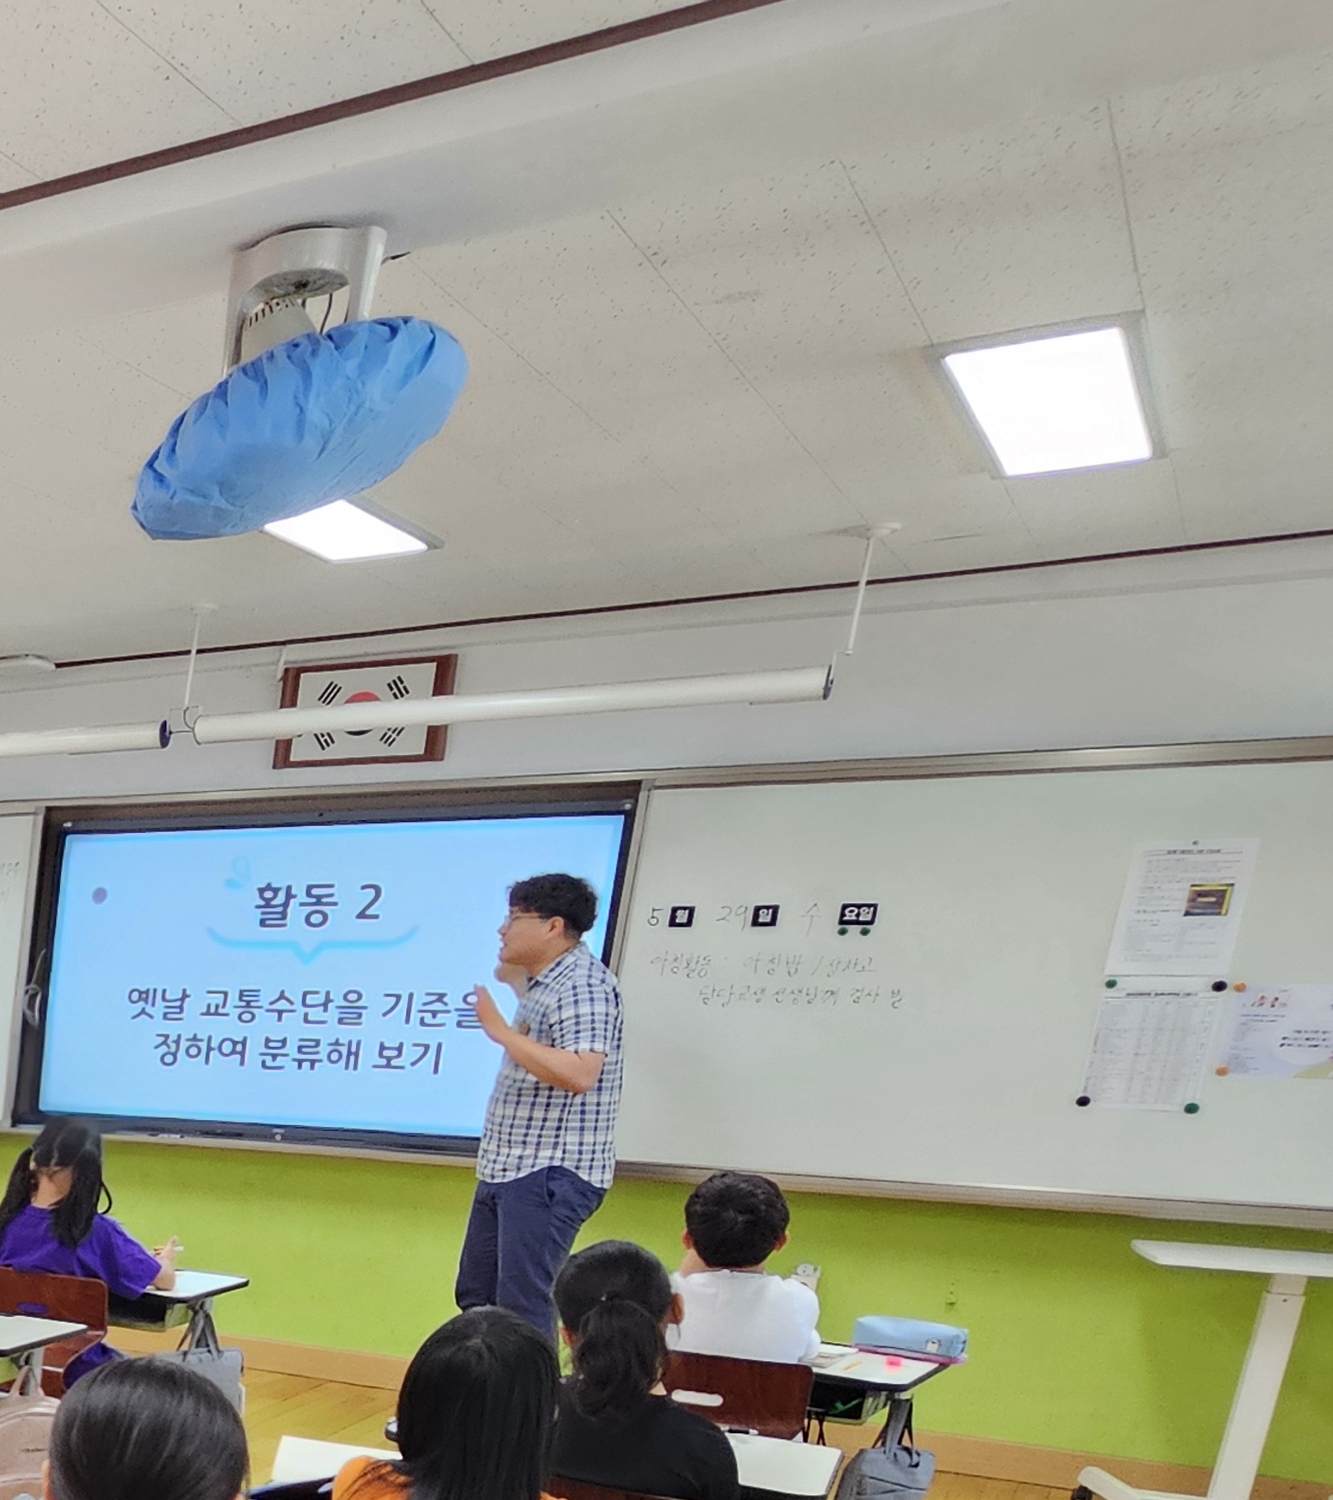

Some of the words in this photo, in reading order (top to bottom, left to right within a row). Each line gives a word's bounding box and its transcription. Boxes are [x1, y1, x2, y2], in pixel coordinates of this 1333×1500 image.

[254, 882, 339, 929] 활동
[355, 883, 384, 921] 2
[646, 907, 664, 927] 5
[715, 905, 749, 931] 29
[800, 902, 823, 937] 수
[841, 906, 874, 922] 요일
[127, 986, 192, 1021] 옛날
[199, 987, 369, 1027] 교통수단을
[381, 990, 483, 1030] 기준을
[153, 1032, 248, 1068] 정하여
[258, 1035, 362, 1072] 분류해
[371, 1040, 444, 1076] 보기
